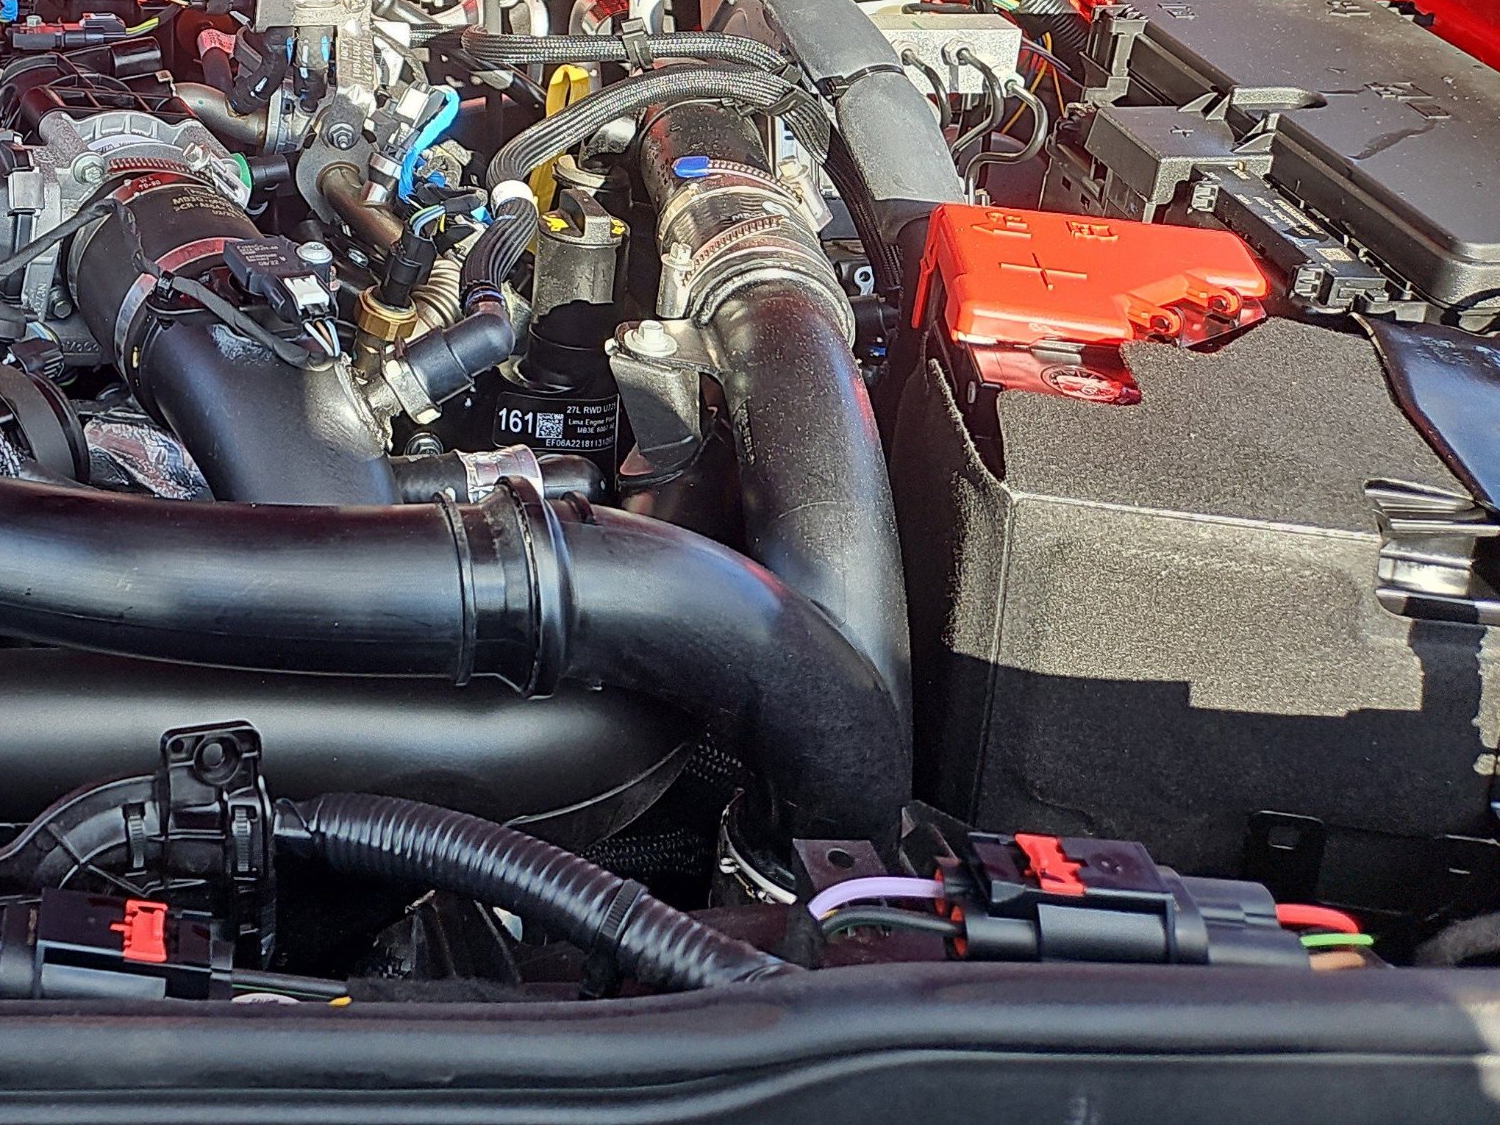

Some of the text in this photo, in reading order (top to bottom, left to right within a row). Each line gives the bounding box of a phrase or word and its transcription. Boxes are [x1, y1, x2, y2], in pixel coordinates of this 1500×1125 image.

[566, 406, 582, 414] 27L
[583, 406, 602, 415] RWD
[498, 407, 533, 434] 161
[568, 418, 584, 426] Lima
[585, 418, 605, 427] Engine
